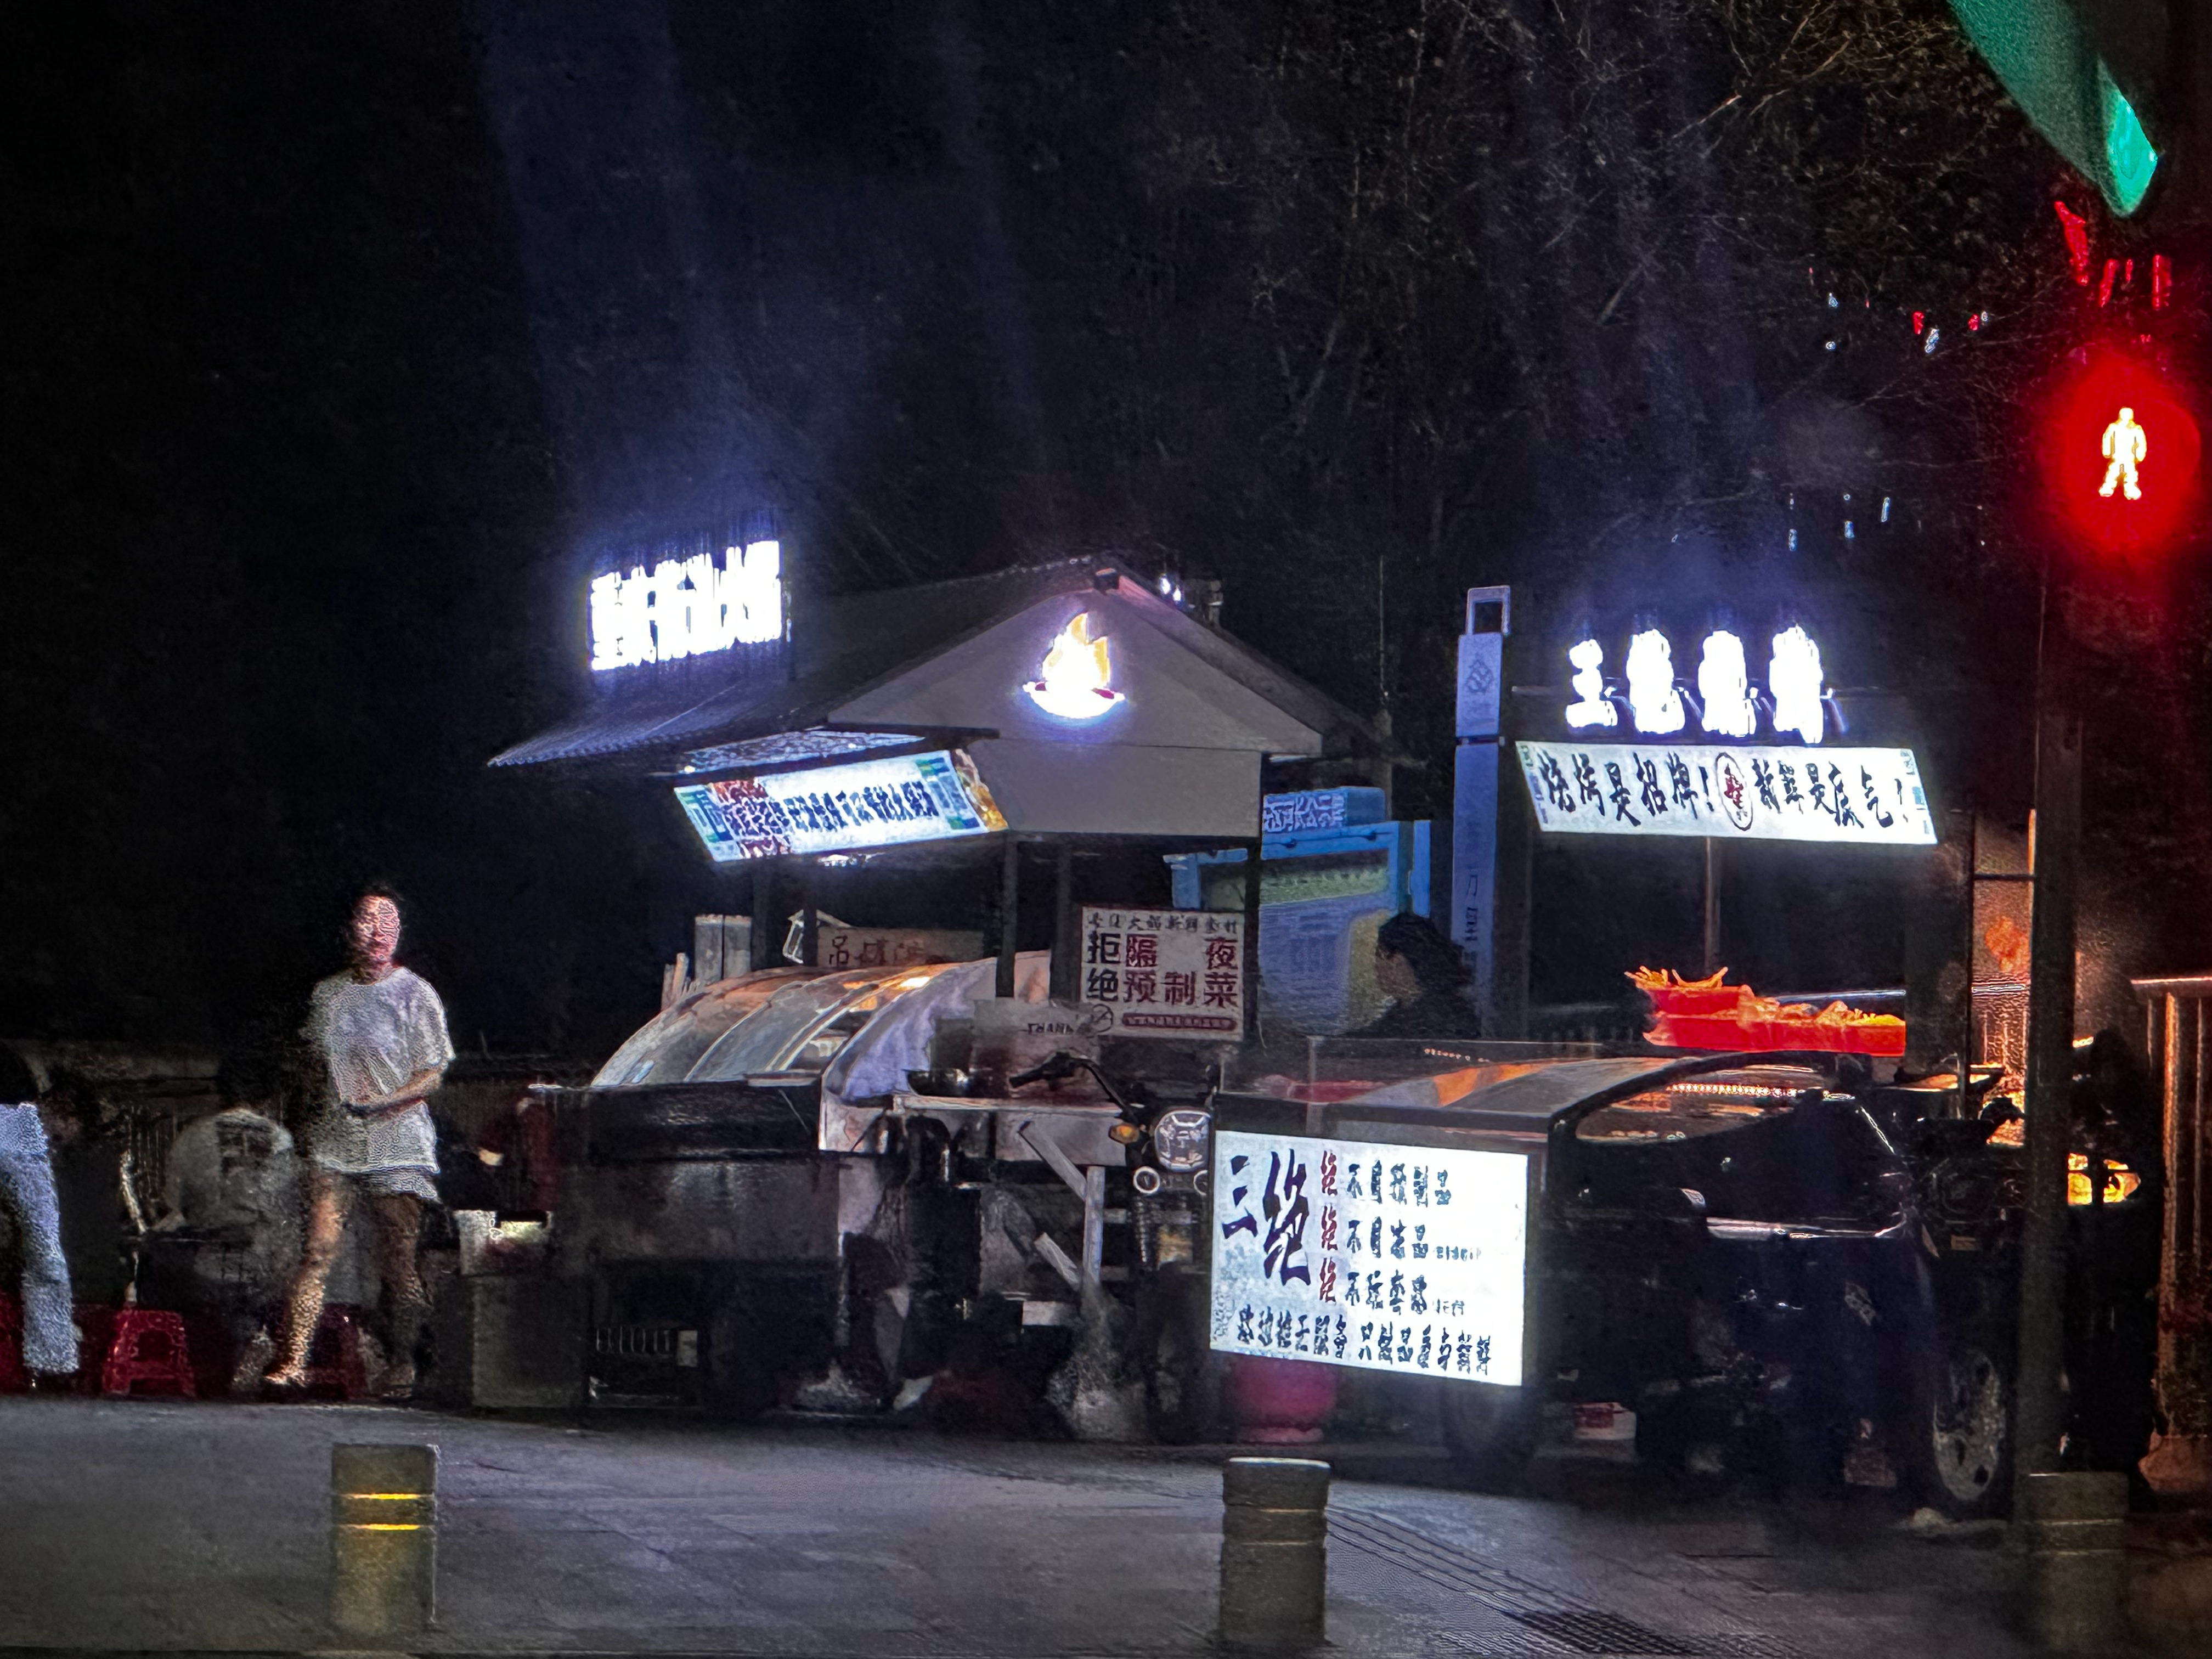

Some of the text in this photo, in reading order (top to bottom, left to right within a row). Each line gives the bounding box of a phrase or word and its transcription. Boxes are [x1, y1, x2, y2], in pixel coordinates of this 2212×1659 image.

[1086, 931, 1122, 1003] 拒绝
[1123, 969, 1239, 1009] 预制菜
[1222, 1148, 1311, 1286] 三绝
